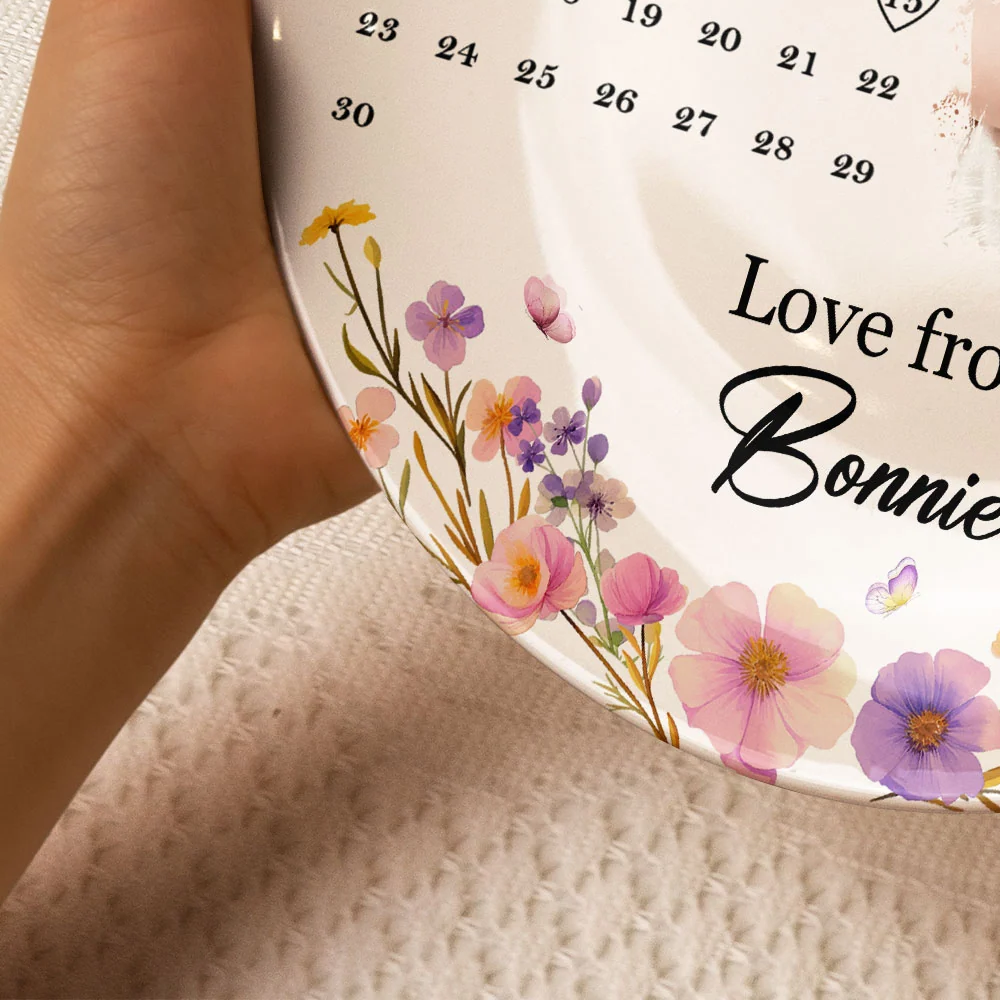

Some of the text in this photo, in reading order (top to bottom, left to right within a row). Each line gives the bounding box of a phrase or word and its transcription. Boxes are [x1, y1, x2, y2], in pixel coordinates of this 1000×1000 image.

[355, 11, 875, 185] 23 24 25 26 27 28 29
[697, 21, 742, 53] 20
[776, 44, 817, 78] 21
[855, 68, 900, 101] 22
[331, 96, 375, 128] 30
[728, 253, 894, 358] Love
